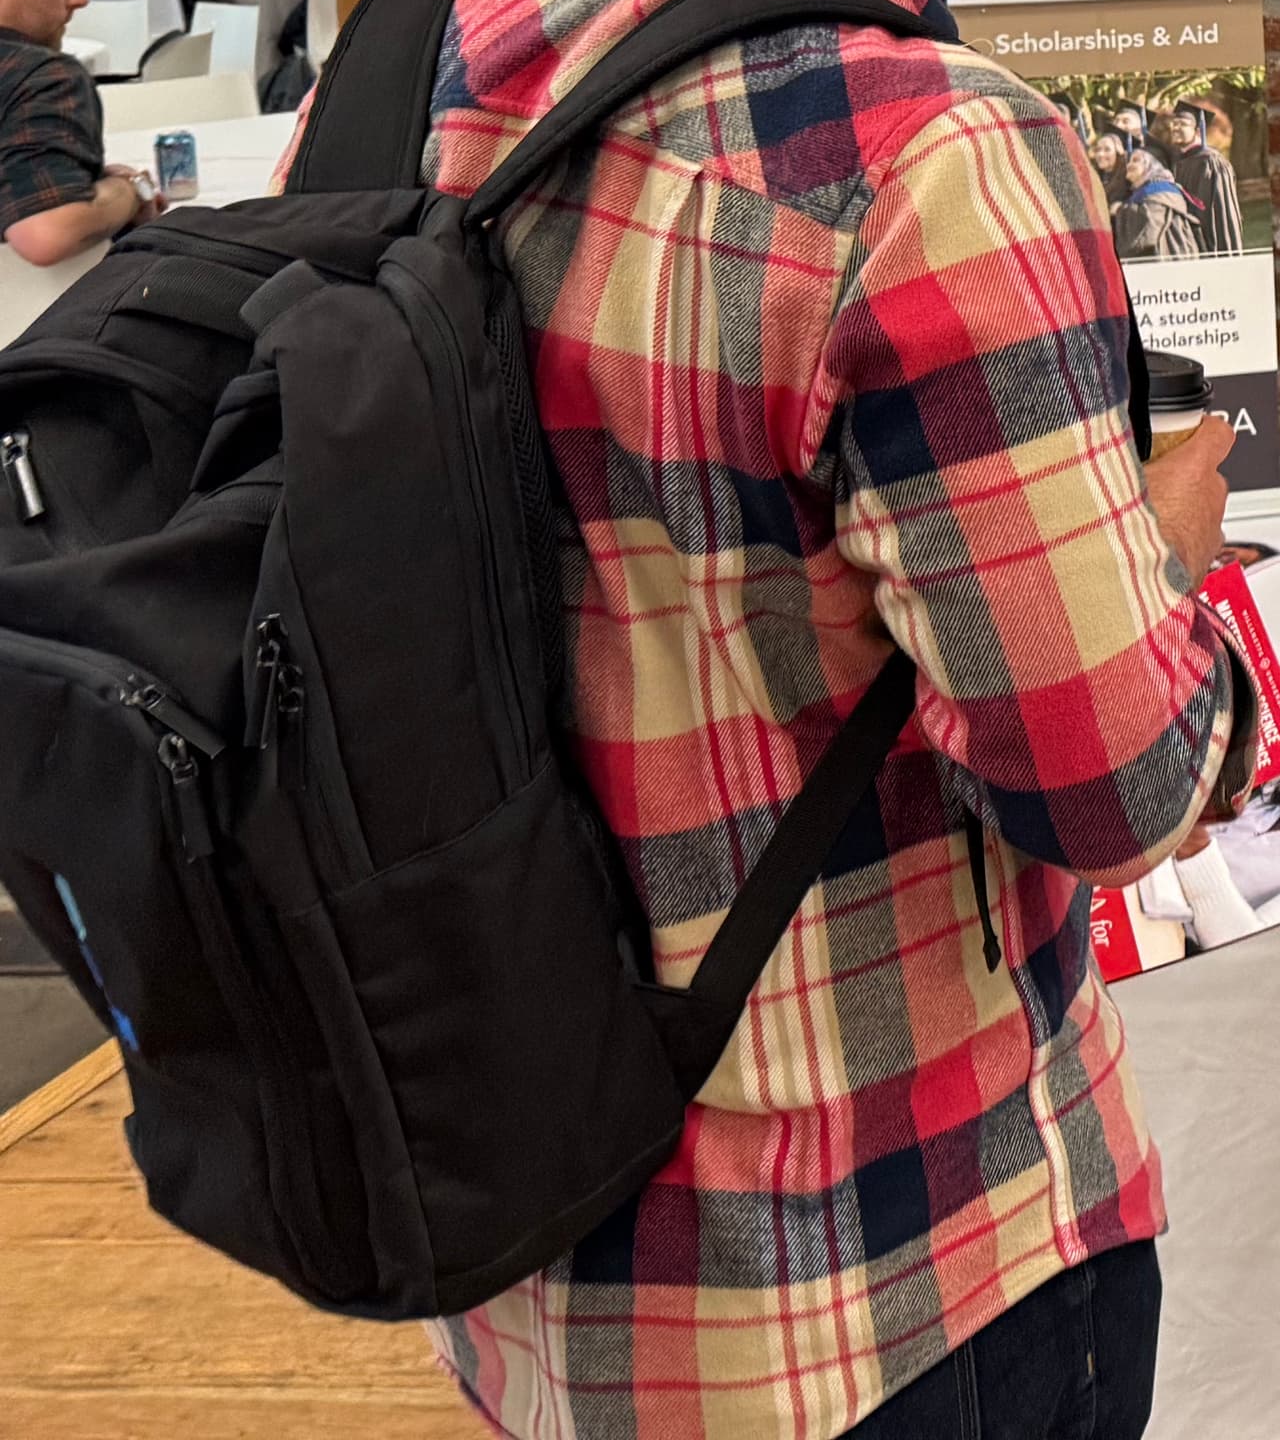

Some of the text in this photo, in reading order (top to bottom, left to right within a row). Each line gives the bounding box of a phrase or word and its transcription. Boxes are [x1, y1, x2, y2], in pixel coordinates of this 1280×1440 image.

[996, 22, 1219, 54] Scholarships & Aid
[1131, 286, 1201, 306] dmitted
[1159, 308, 1236, 326] students
[1091, 919, 1113, 948] for
